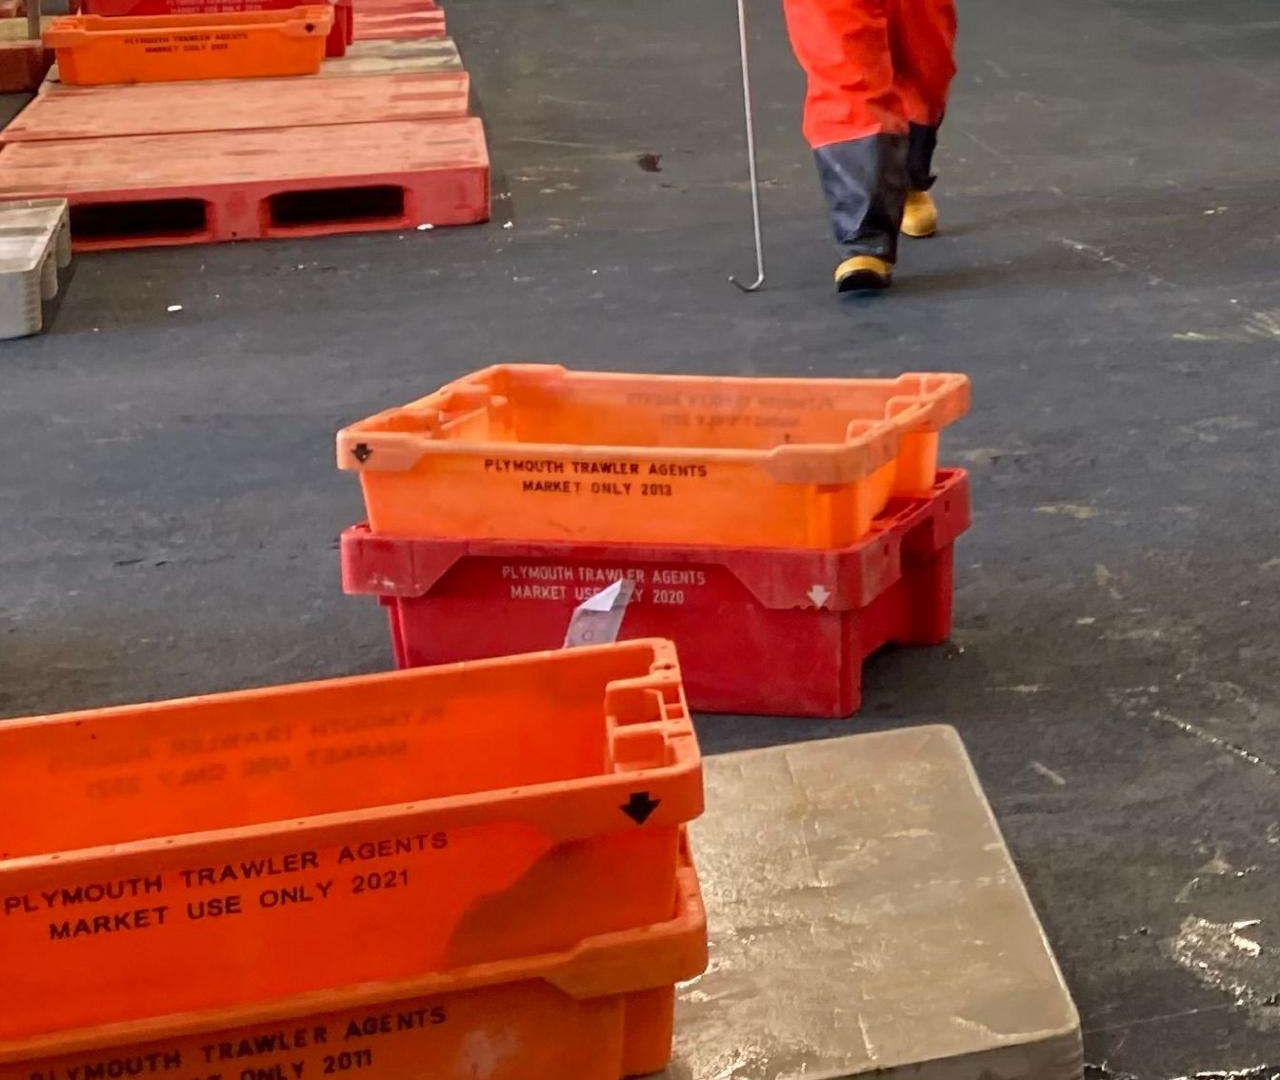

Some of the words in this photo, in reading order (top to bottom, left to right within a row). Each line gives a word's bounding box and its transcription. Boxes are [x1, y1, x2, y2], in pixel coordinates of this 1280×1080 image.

[484, 459, 564, 474] PLYMOUTH
[572, 461, 640, 475] TRAWLER
[648, 463, 708, 478] AGENTS
[522, 480, 581, 495] MARKET
[591, 482, 632, 496] ONLY
[501, 565, 573, 581] PLYMOUTH
[578, 567, 645, 583] TRAWLER
[652, 570, 706, 586] AGENTS
[510, 585, 567, 600] MARKET
[653, 589, 684, 605] 2020
[4, 873, 162, 915] PLYMOUTH
[180, 850, 319, 889] TRAWLER
[337, 831, 448, 864] AGENTS
[48, 906, 169, 941] MARKET
[187, 895, 241, 921] USE
[259, 880, 334, 910] ONLY
[352, 869, 409, 894] 2021
[200, 1025, 328, 1064] TRAWLER
[344, 1005, 447, 1041] AGENTS
[240, 1057, 305, 1080] ONLY
[324, 1049, 372, 1074] 2011
